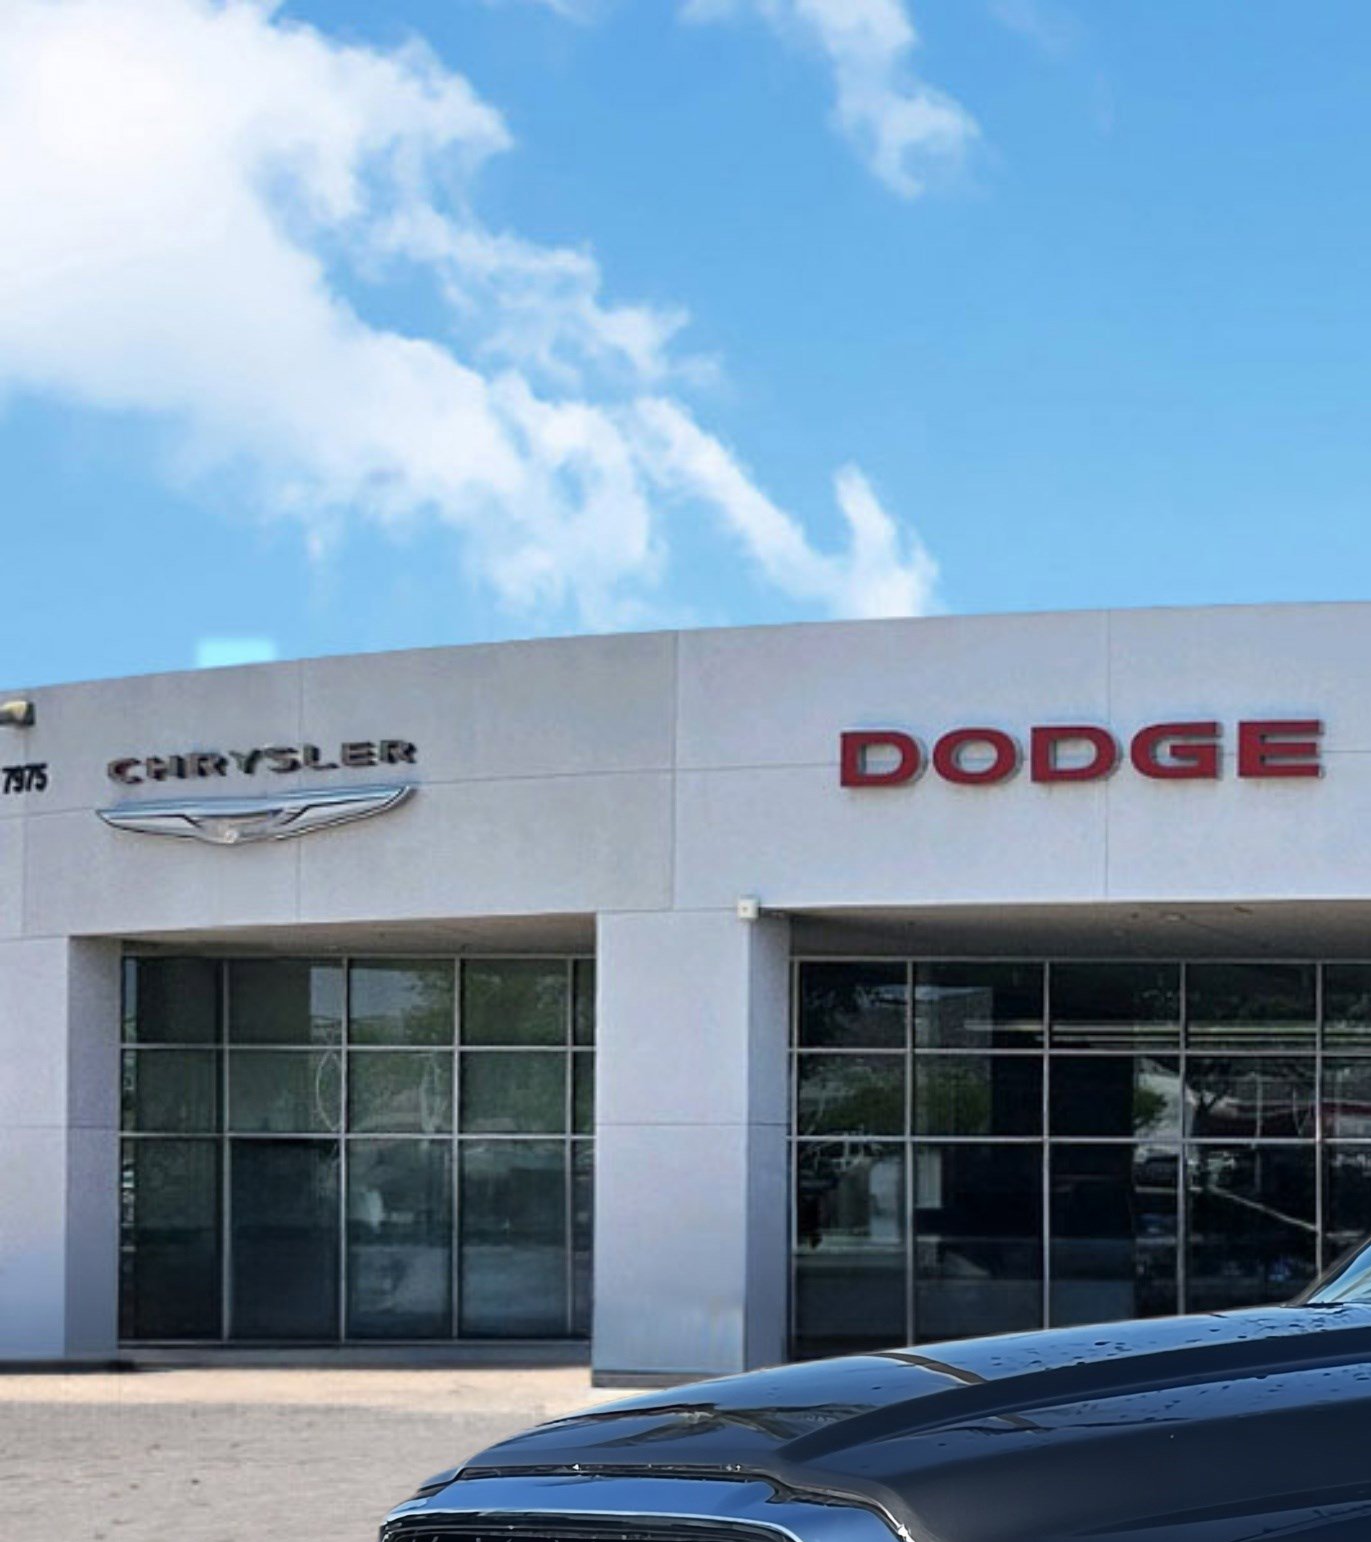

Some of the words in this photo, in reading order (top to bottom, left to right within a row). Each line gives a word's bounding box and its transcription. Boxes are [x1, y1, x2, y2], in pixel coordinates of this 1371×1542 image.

[106, 737, 419, 786] CHRYSLER
[840, 719, 1324, 788] DODGE
[2, 763, 48, 795] 7975
